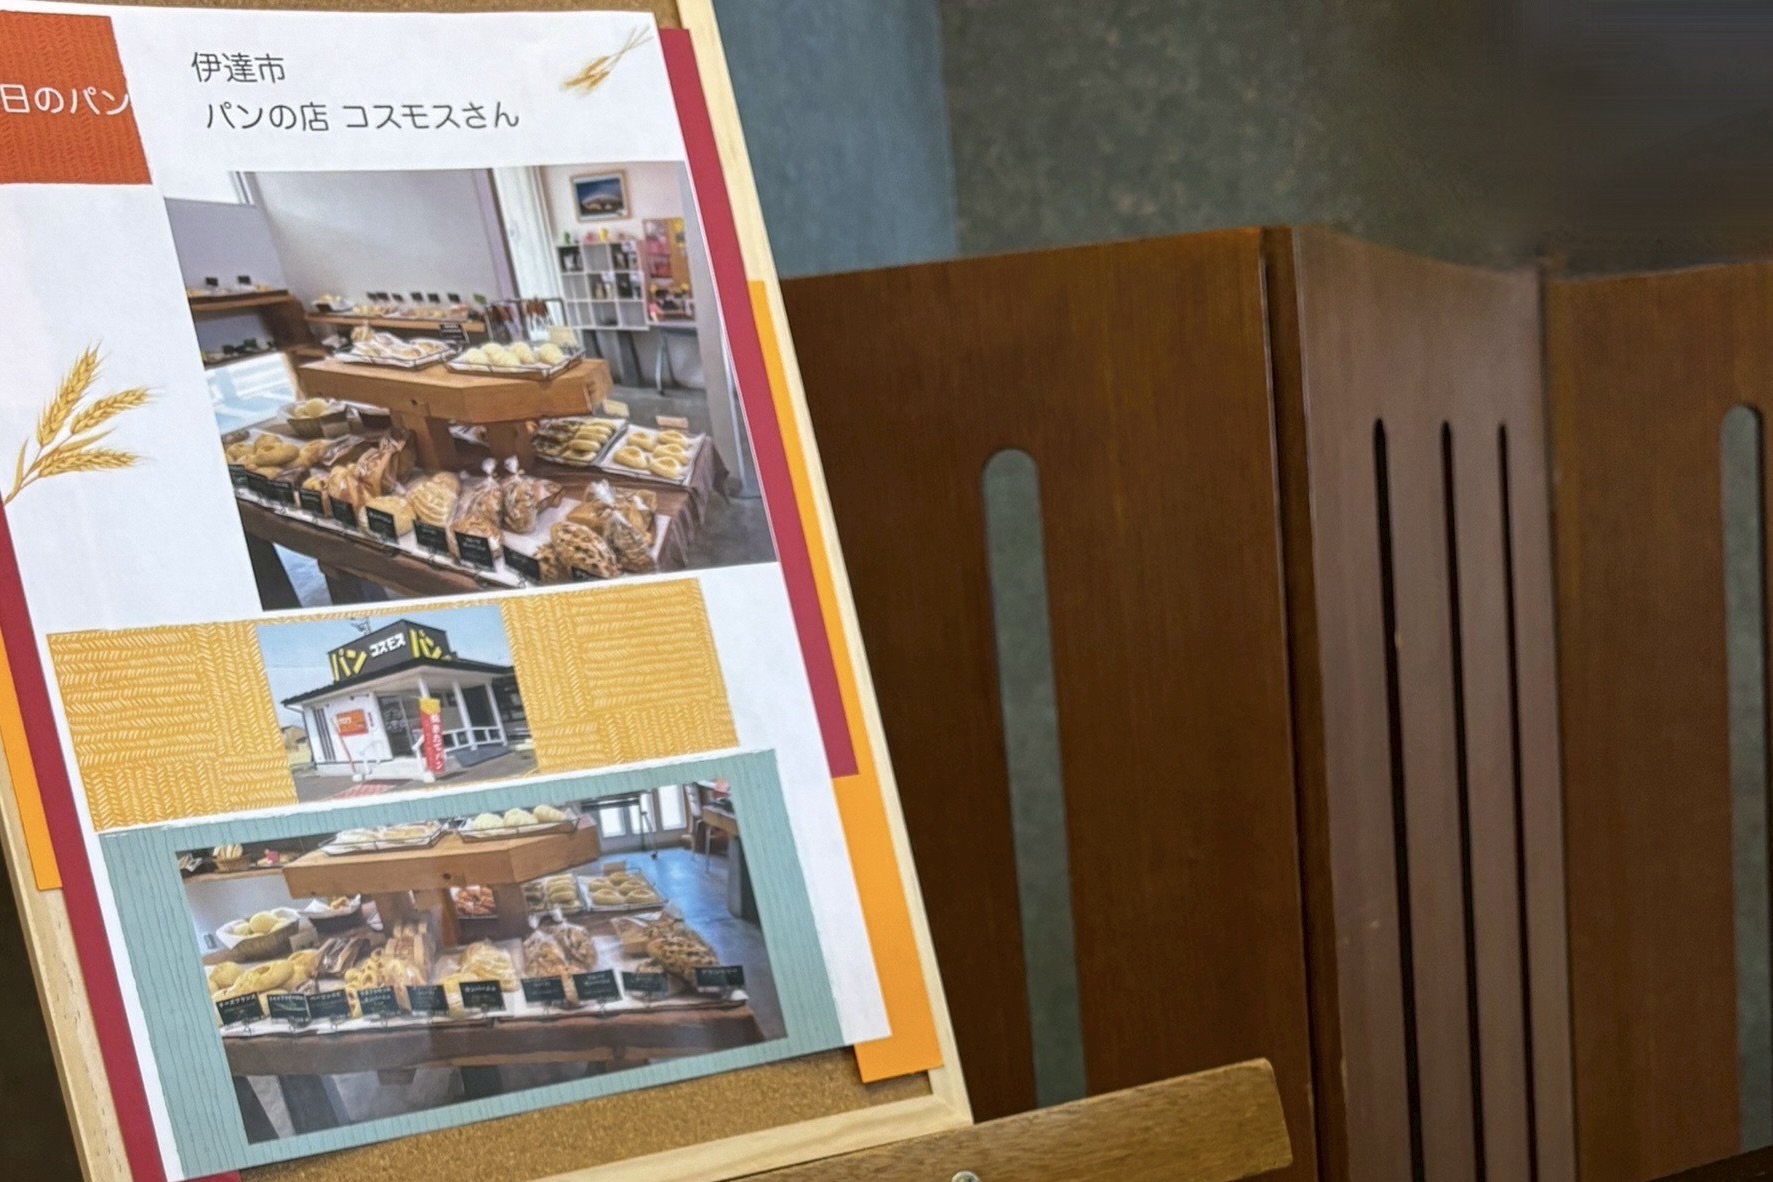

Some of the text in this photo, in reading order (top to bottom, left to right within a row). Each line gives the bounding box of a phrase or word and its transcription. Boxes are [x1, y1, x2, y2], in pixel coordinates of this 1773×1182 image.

[191, 51, 286, 84] 伊達市
[0, 84, 129, 115] 日のパン
[206, 101, 520, 132] パンの店 コスモスさん
[331, 632, 406, 682] パン コスモス
